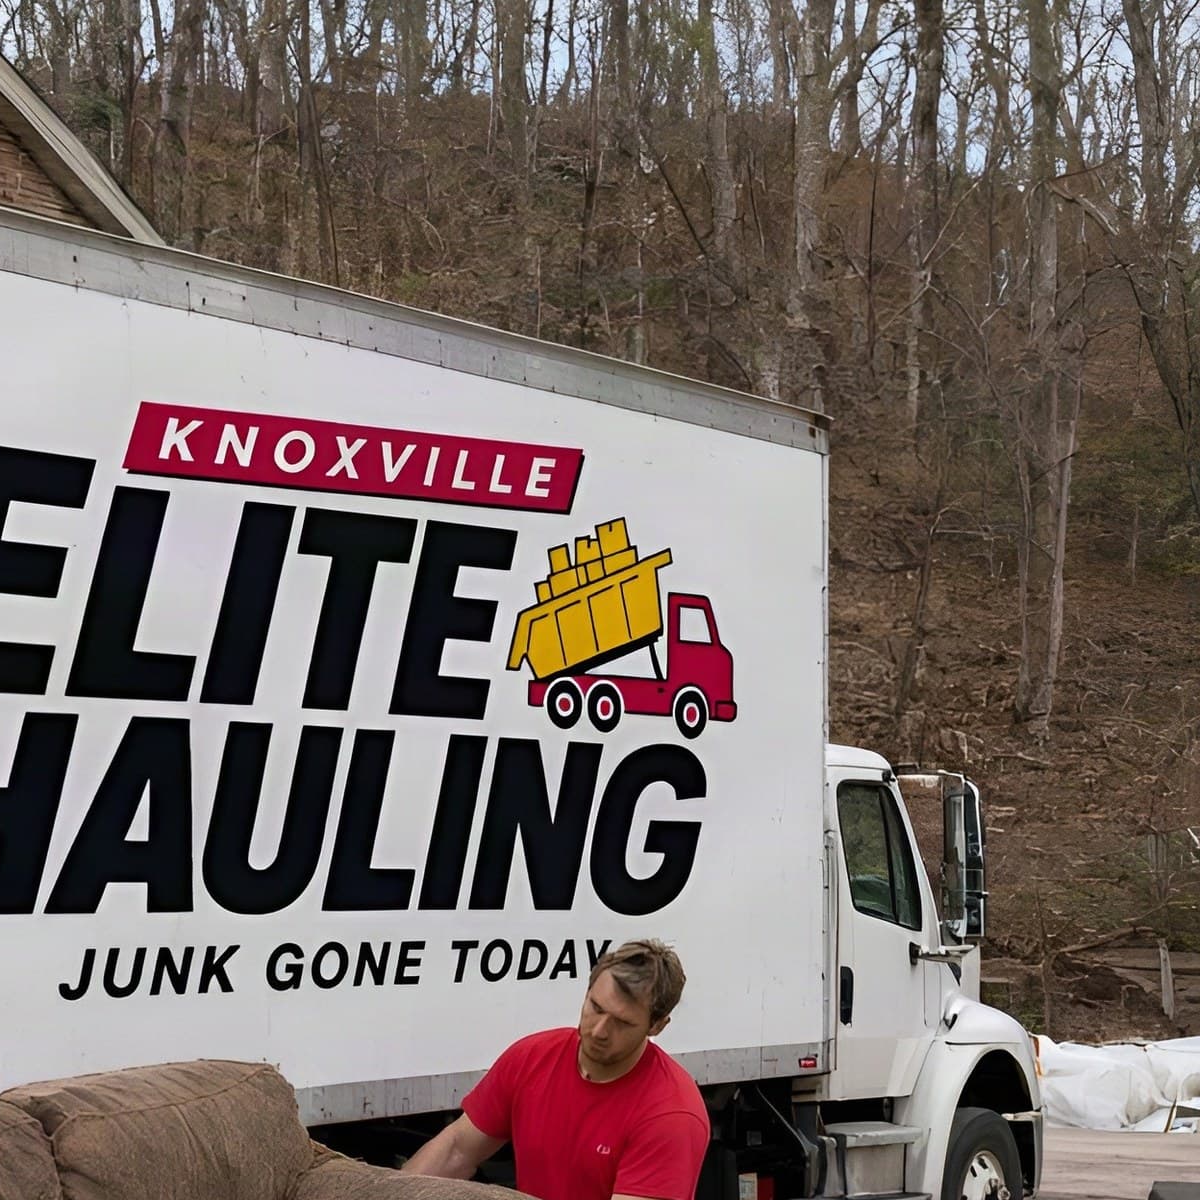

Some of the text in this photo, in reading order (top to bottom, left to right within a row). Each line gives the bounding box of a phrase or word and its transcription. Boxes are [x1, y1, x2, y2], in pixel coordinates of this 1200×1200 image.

[158, 417, 557, 499] KNOXVILLE
[57, 938, 613, 1001] JUNK GONE TODAY
